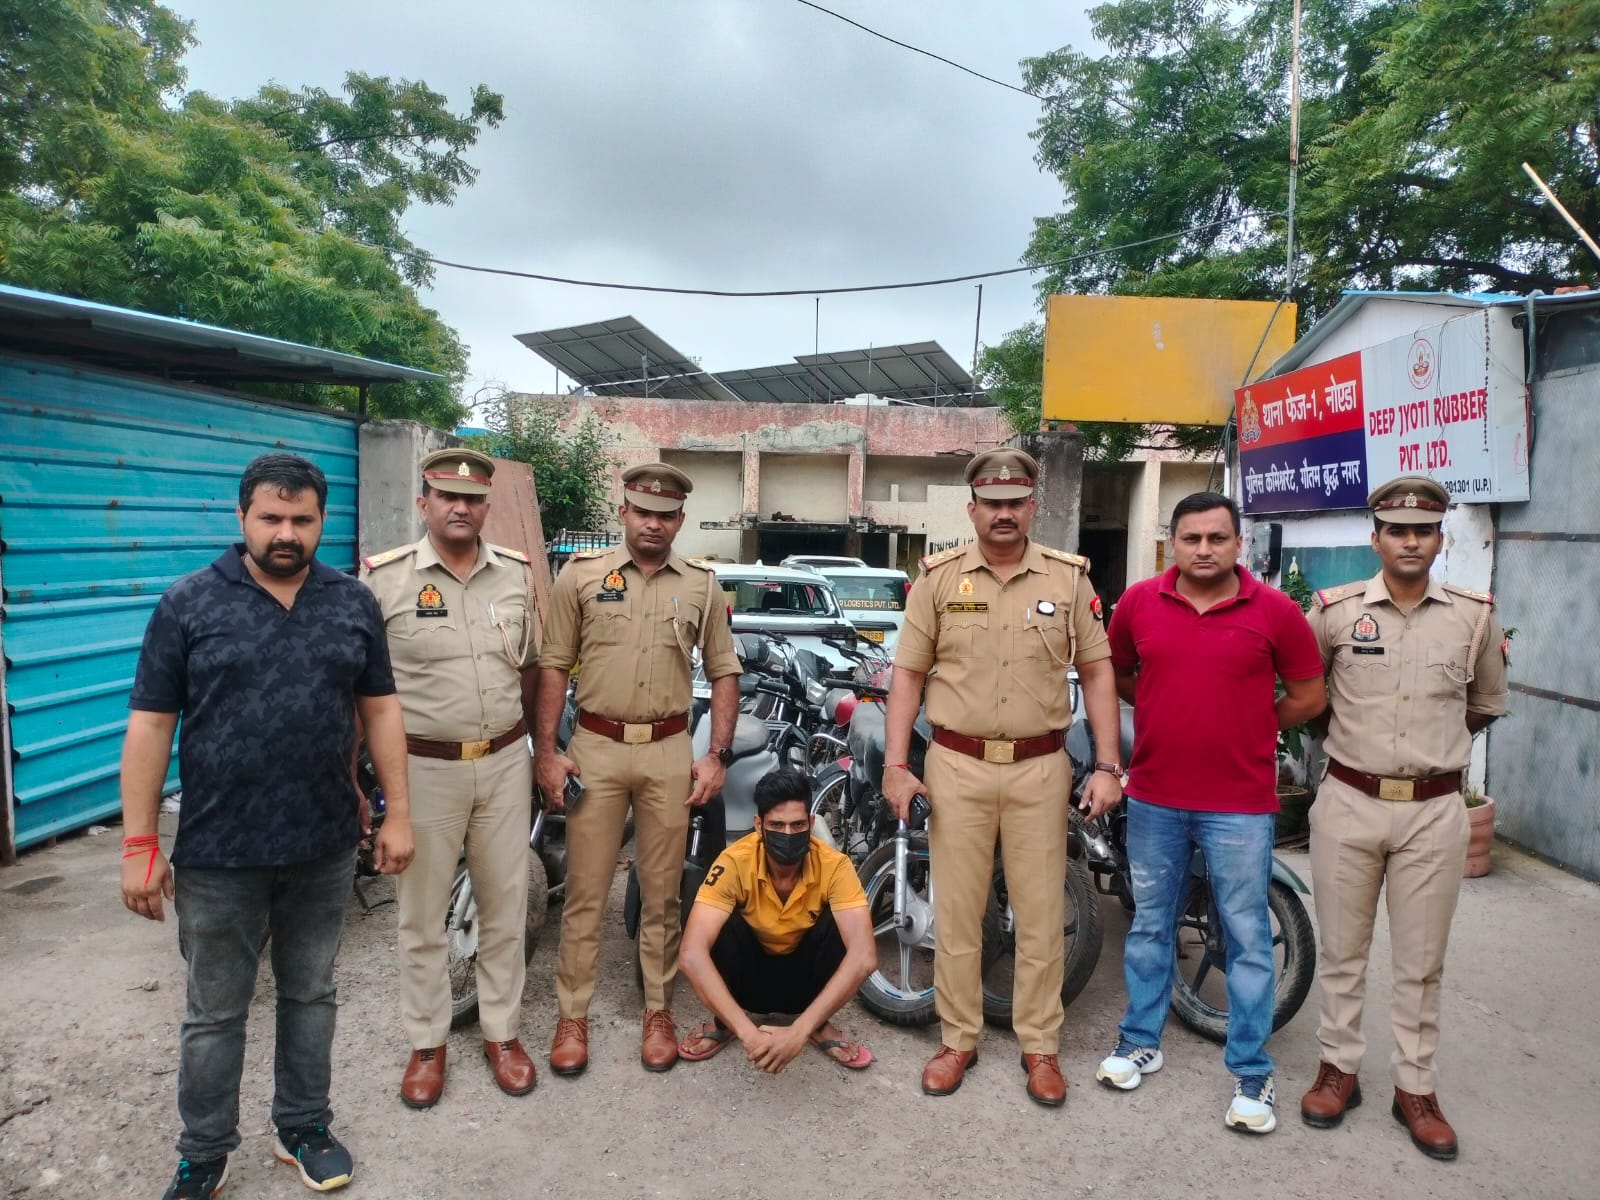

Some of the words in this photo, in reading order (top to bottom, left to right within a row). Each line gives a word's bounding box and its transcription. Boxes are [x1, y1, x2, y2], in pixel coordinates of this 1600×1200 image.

[1262, 400, 1284, 428] थाना
[1324, 373, 1357, 413] नोएडा
[1369, 407, 1395, 437] DEEP
[1398, 399, 1430, 438] JYOTI
[1433, 388, 1487, 427] RUBBER
[1399, 443, 1423, 472] PVT.
[1426, 439, 1452, 470] LTD.
[1245, 466, 1264, 504] पुलिस
[1299, 456, 1321, 489] गौतम
[1321, 462, 1339, 497] बुद्ध
[1340, 460, 1361, 486] नगर
[1472, 477, 1492, 496] (U.P.)
[843, 599, 874, 608] LOGISTICS
[704, 864, 725, 887] 3
